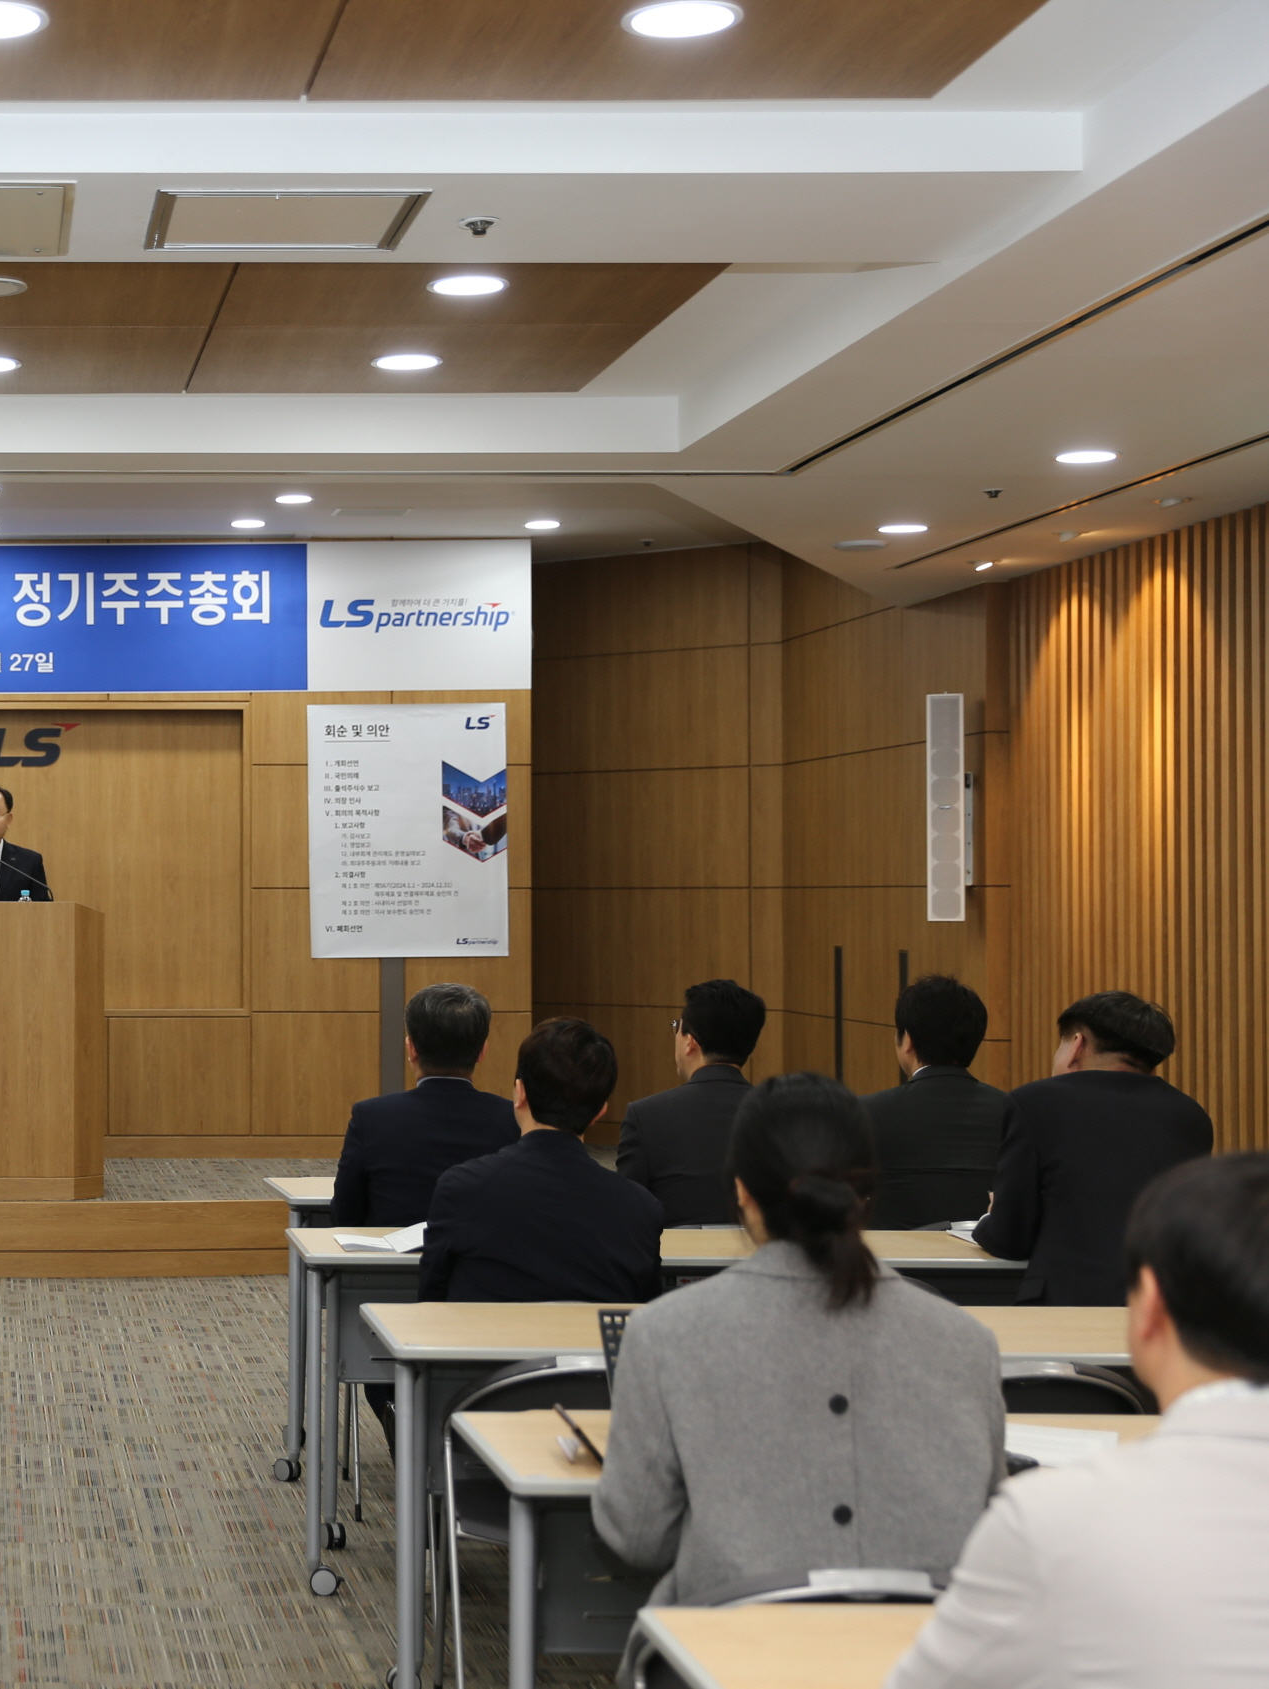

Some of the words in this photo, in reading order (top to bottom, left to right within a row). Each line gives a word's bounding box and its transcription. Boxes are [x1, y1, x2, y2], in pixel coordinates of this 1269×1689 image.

[13, 570, 271, 626] 정기주주총회
[391, 599, 421, 608] 함께하여
[423, 599, 431, 607] 더
[432, 598, 440, 607] 큰
[9, 652, 54, 673] 27일
[464, 716, 490, 730] LS
[324, 724, 348, 738] 회순
[351, 724, 363, 738] 및
[366, 724, 390, 737] 의안
[334, 759, 359, 768] 개회선언
[334, 772, 359, 780] 국민의례
[334, 784, 366, 792] 출석주식수
[367, 784, 380, 792] 보고
[334, 797, 347, 805] 의장
[348, 797, 361, 805] 인사
[334, 809, 354, 817] 회의의
[355, 809, 380, 817] 목적사항
[342, 821, 365, 829] 보고사항
[342, 871, 366, 879] 의결사항
[336, 925, 363, 933] 폐회선언
